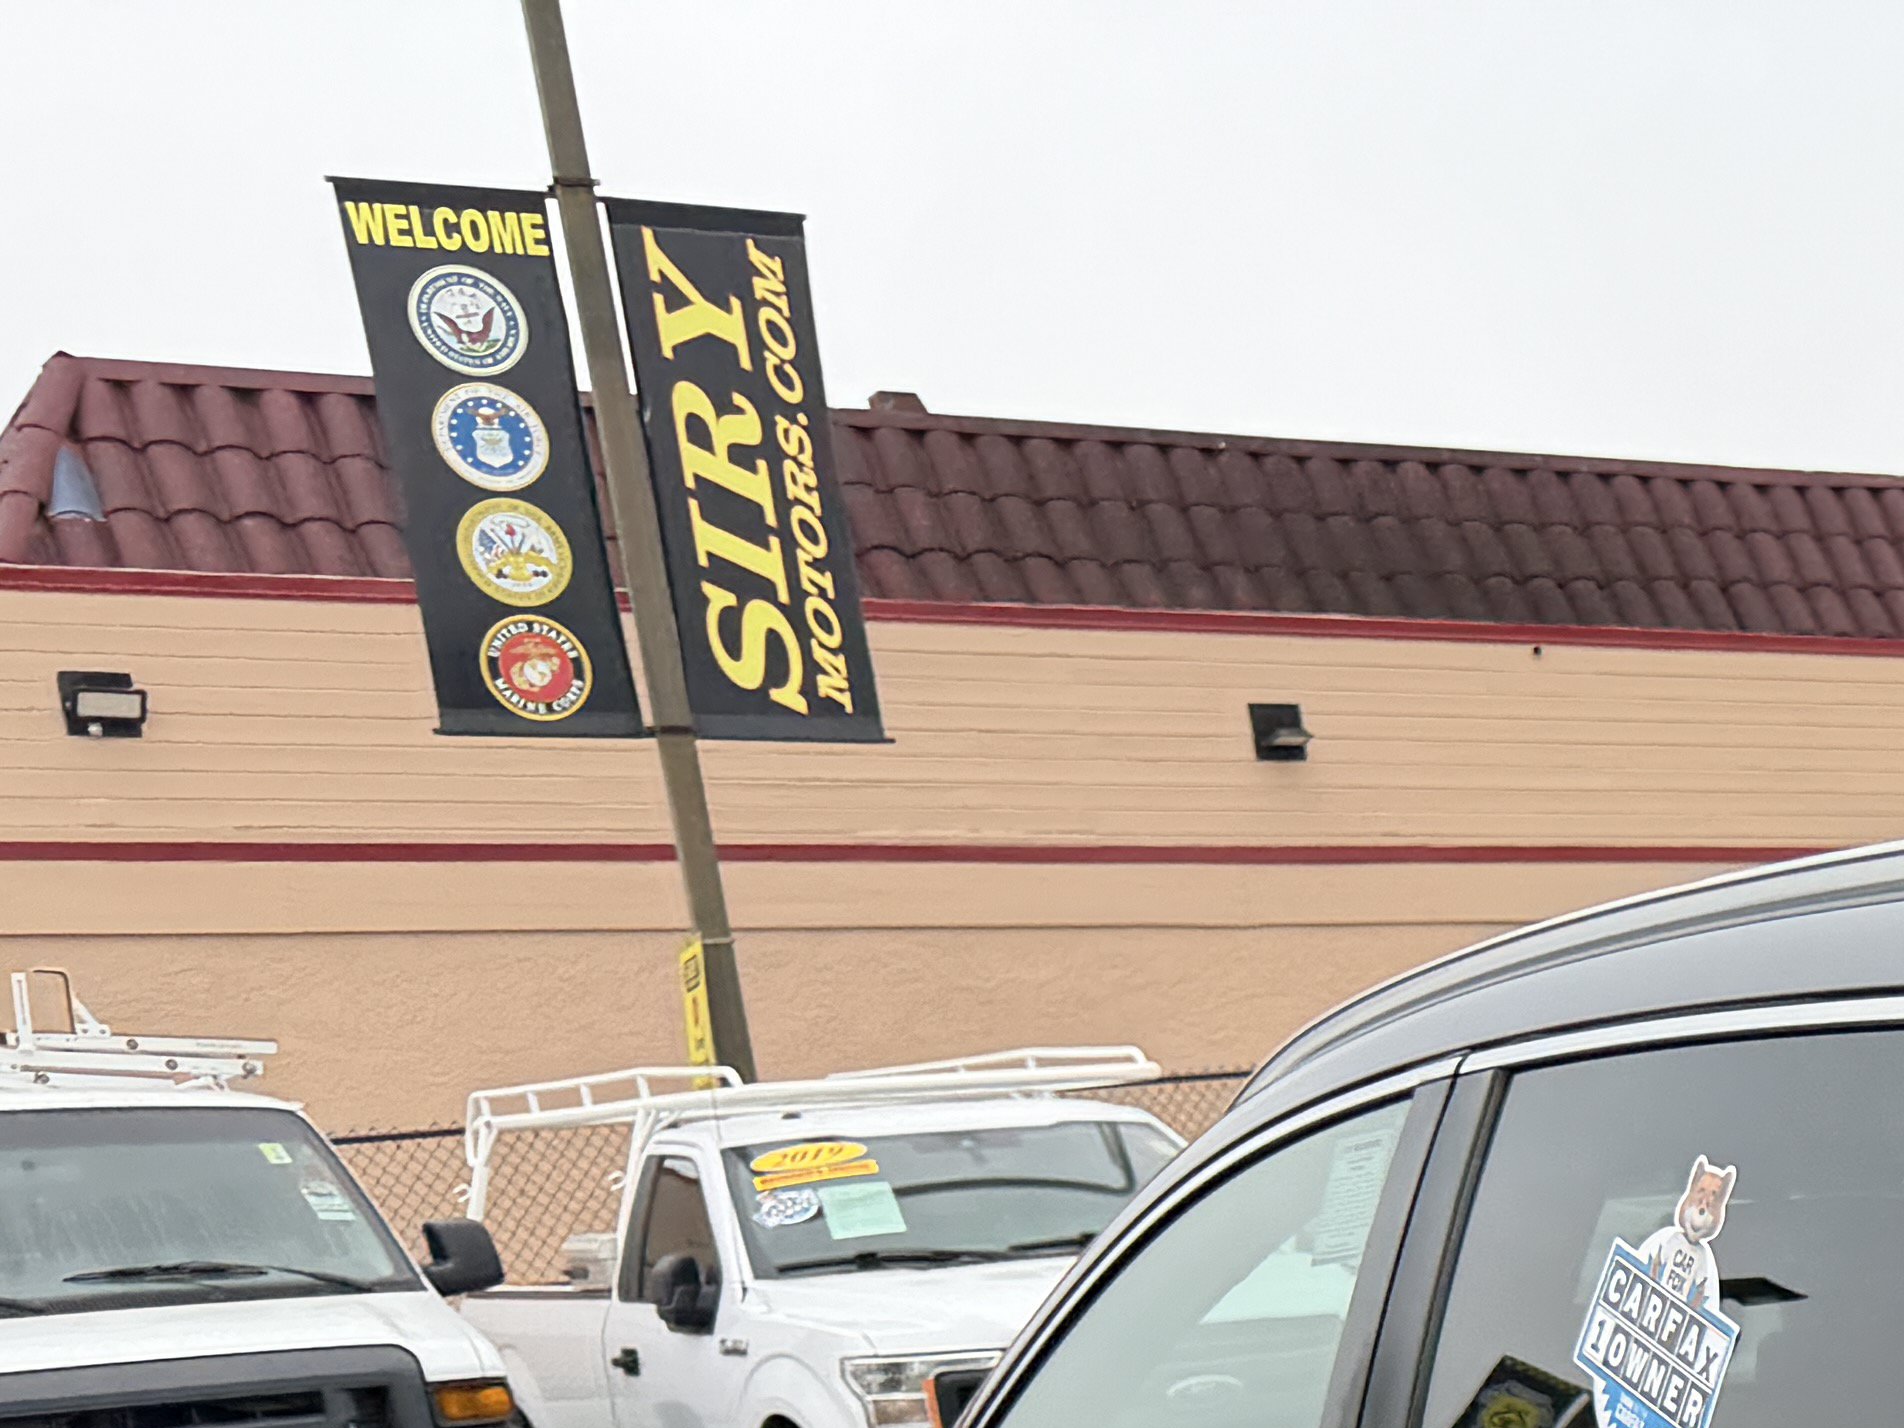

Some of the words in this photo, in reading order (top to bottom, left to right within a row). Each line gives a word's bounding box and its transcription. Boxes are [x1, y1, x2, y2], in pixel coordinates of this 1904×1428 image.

[344, 201, 550, 256] WELCOME
[641, 225, 809, 716] SIRY
[745, 238, 853, 714] MOTORS.COM
[488, 622, 528, 658] UNITED
[533, 622, 579, 659] STATES
[494, 678, 547, 715] MARINE
[1673, 1249, 1695, 1275] CAR
[1608, 1269, 1718, 1384] CARFAX
[1608, 1333, 1704, 1428] OWNER
